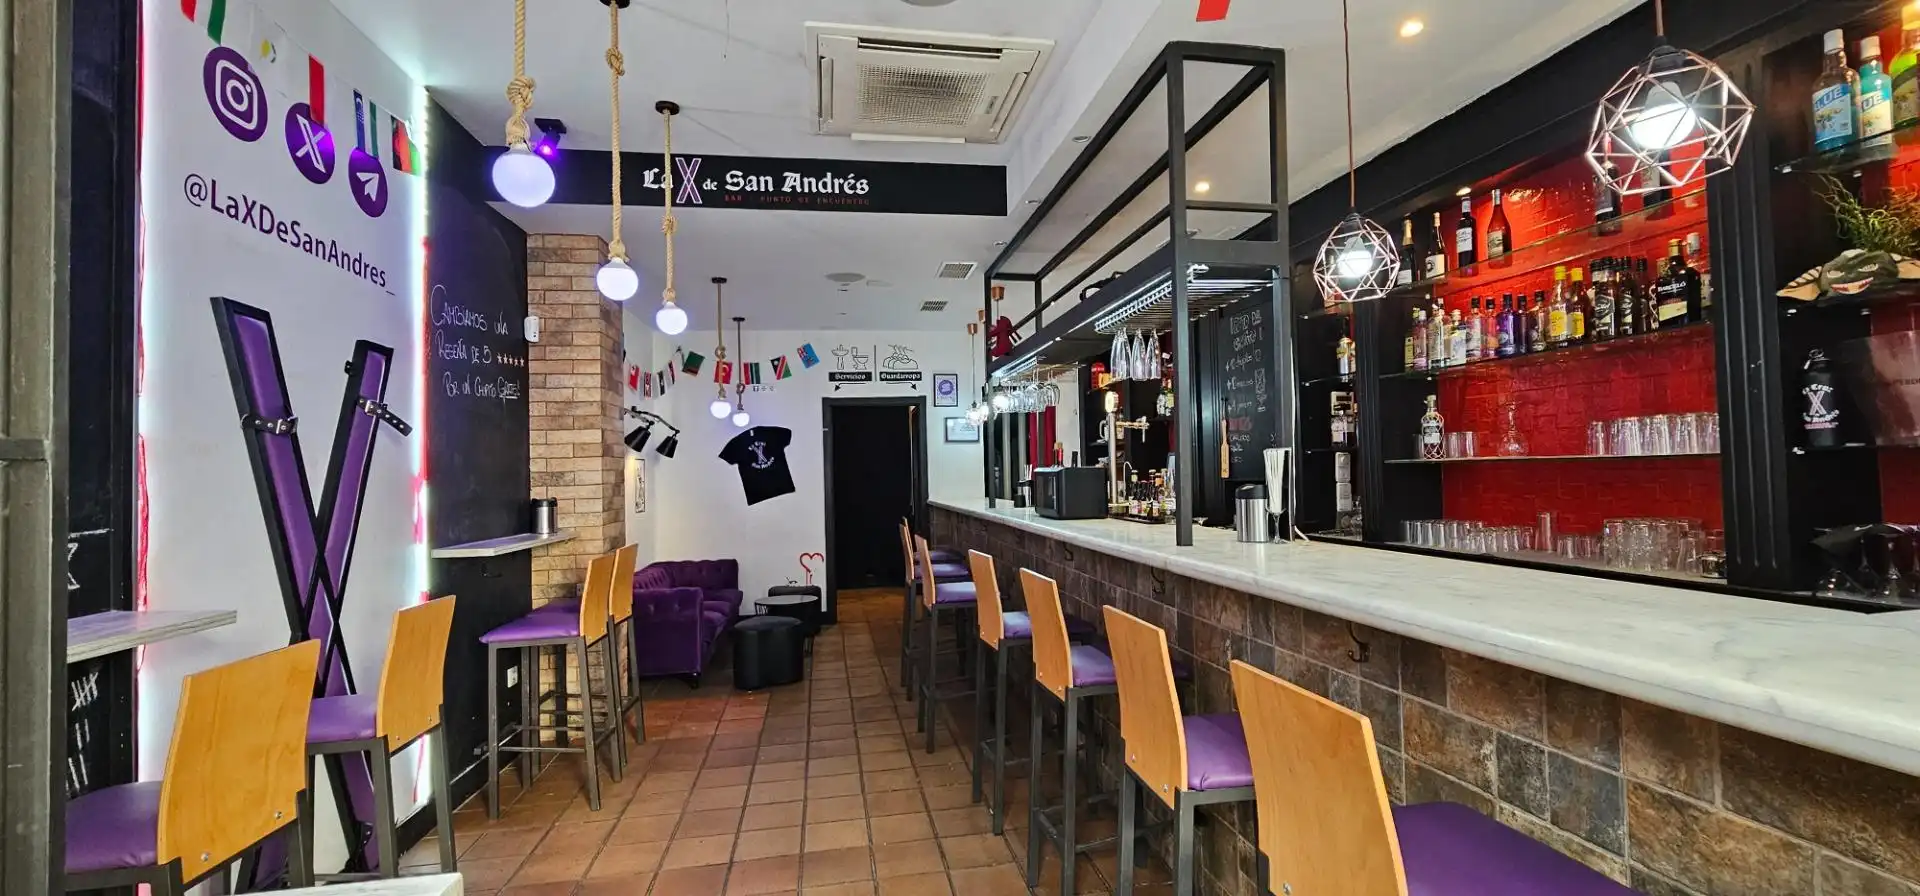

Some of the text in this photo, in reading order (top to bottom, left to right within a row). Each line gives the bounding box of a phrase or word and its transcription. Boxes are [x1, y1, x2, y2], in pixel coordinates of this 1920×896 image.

[703, 178, 718, 191] de
[725, 170, 774, 192] San
[781, 171, 870, 195] Andrés
[183, 173, 396, 296] @LaXDeSanAndres_
[482, 345, 492, 364] 5
